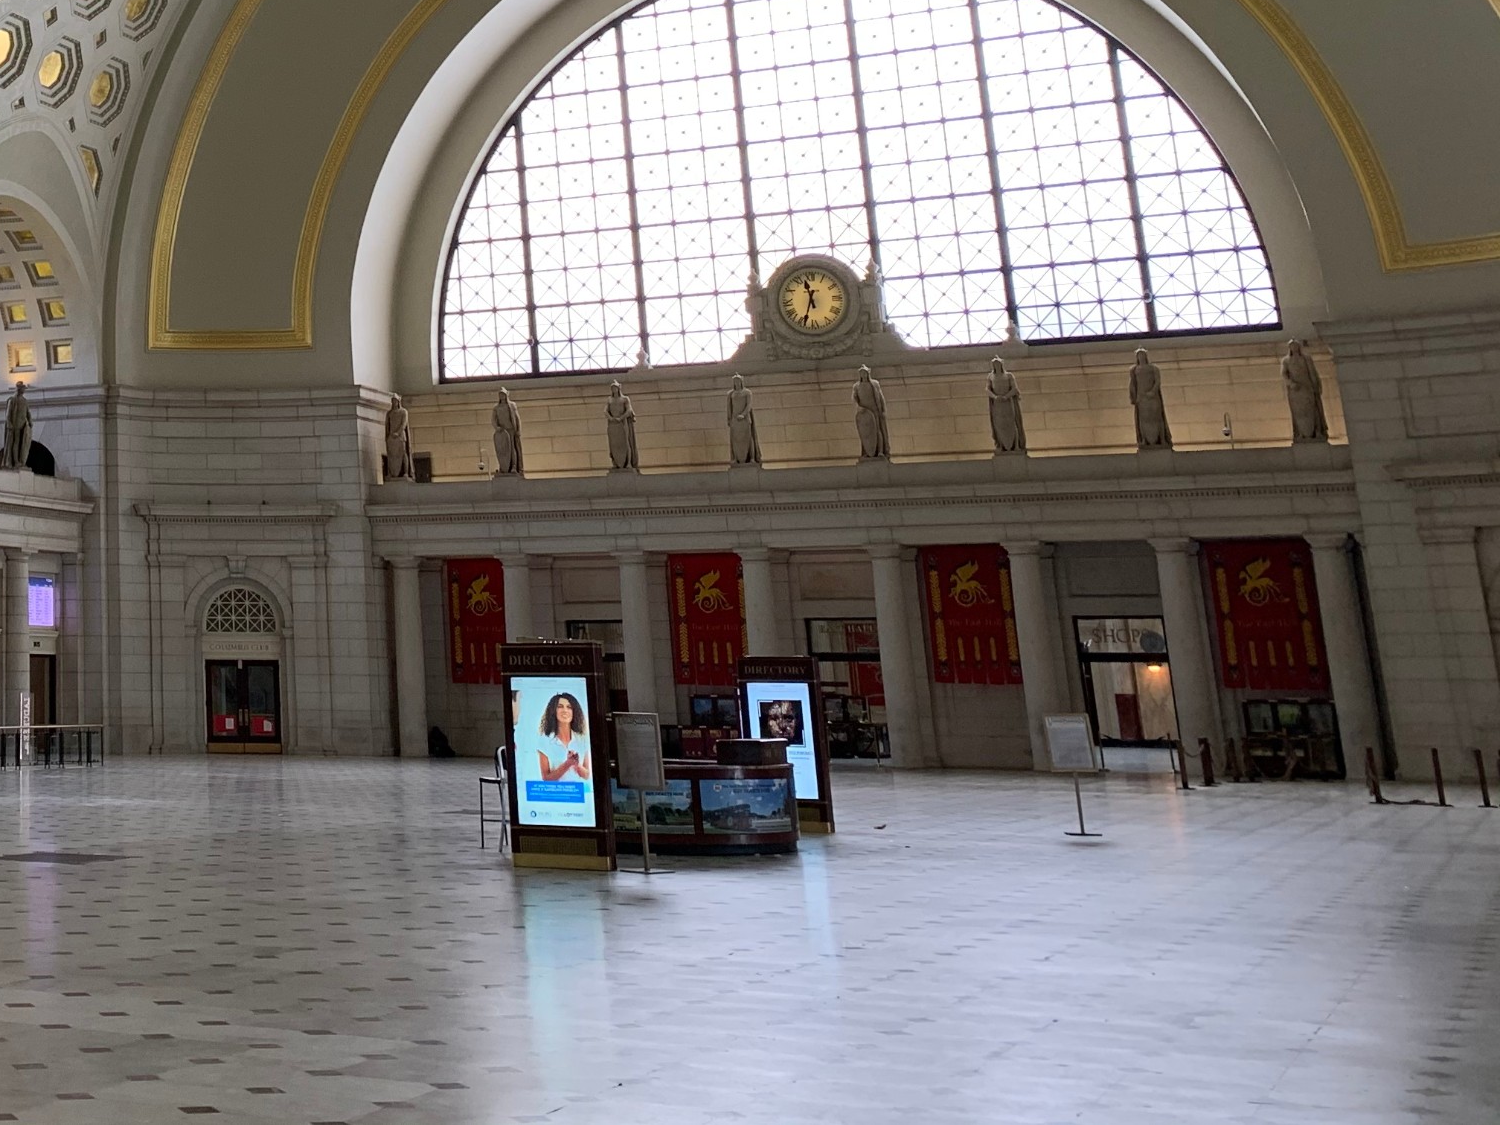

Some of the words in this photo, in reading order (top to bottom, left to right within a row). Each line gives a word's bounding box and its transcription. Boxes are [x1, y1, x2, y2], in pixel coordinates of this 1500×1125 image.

[1092, 628, 1149, 644] SHOP
[509, 655, 583, 666] DIRECTORY
[744, 665, 806, 675] DIRECTORY
